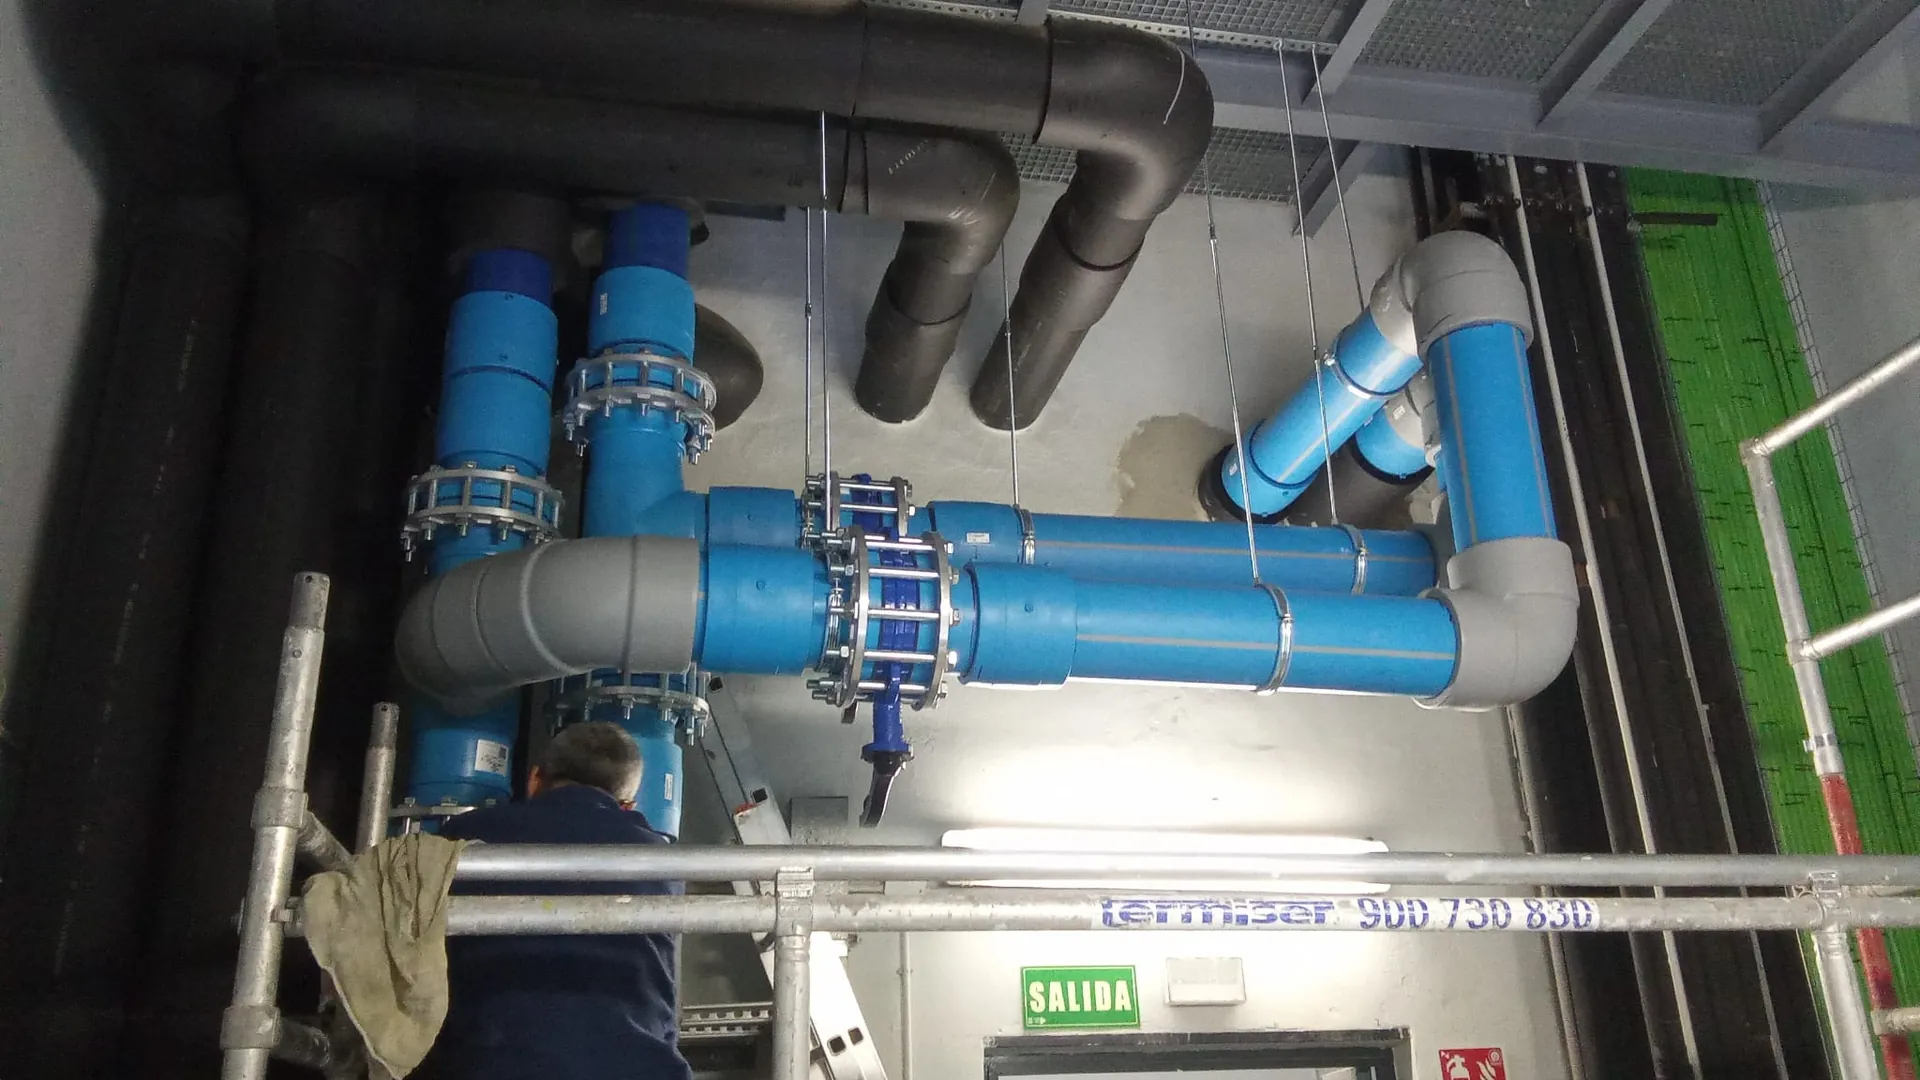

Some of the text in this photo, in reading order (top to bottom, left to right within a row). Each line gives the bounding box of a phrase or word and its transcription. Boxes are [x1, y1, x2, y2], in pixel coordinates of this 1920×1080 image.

[1102, 898, 1593, 929] termiser 900 730 830
[1028, 979, 1132, 1013] SALIDA
